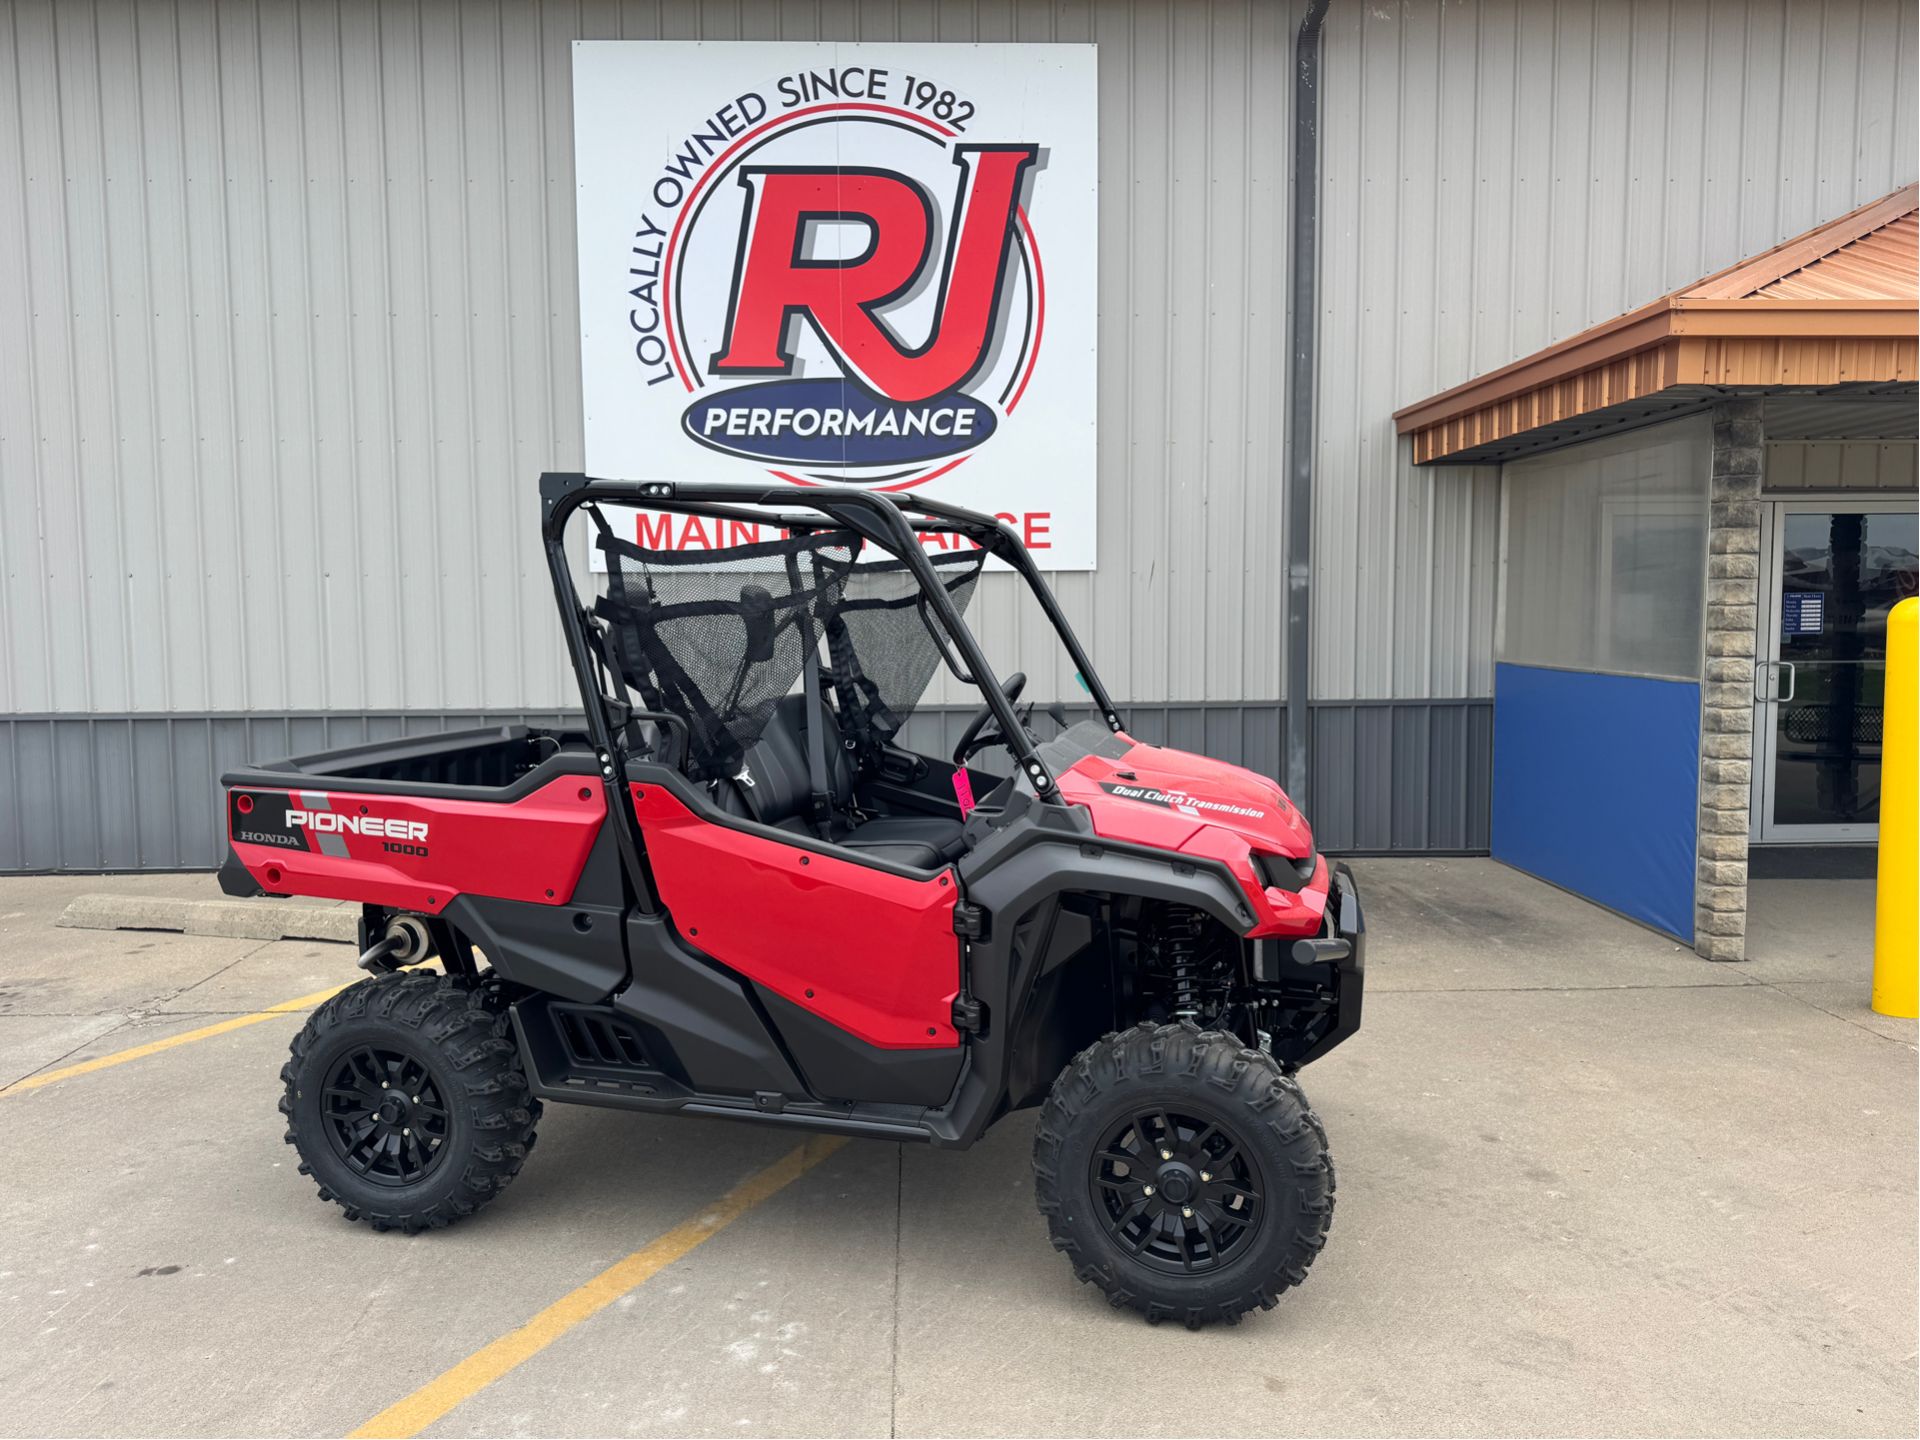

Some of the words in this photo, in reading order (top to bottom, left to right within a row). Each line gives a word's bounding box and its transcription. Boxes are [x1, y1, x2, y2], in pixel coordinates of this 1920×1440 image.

[629, 214, 676, 387] LOCALLY
[653, 91, 768, 208] OWNED
[776, 67, 890, 109] SINCE
[904, 76, 976, 132] 1982
[708, 143, 1039, 402] RJ
[703, 407, 977, 437] PERFORMANCE
[1111, 785, 1143, 798] Dual
[1144, 790, 1184, 805] Clutch
[1185, 797, 1265, 819] Transmission
[240, 830, 300, 847] HONDA
[285, 809, 429, 842] PIONEER
[381, 841, 429, 857] 1000
